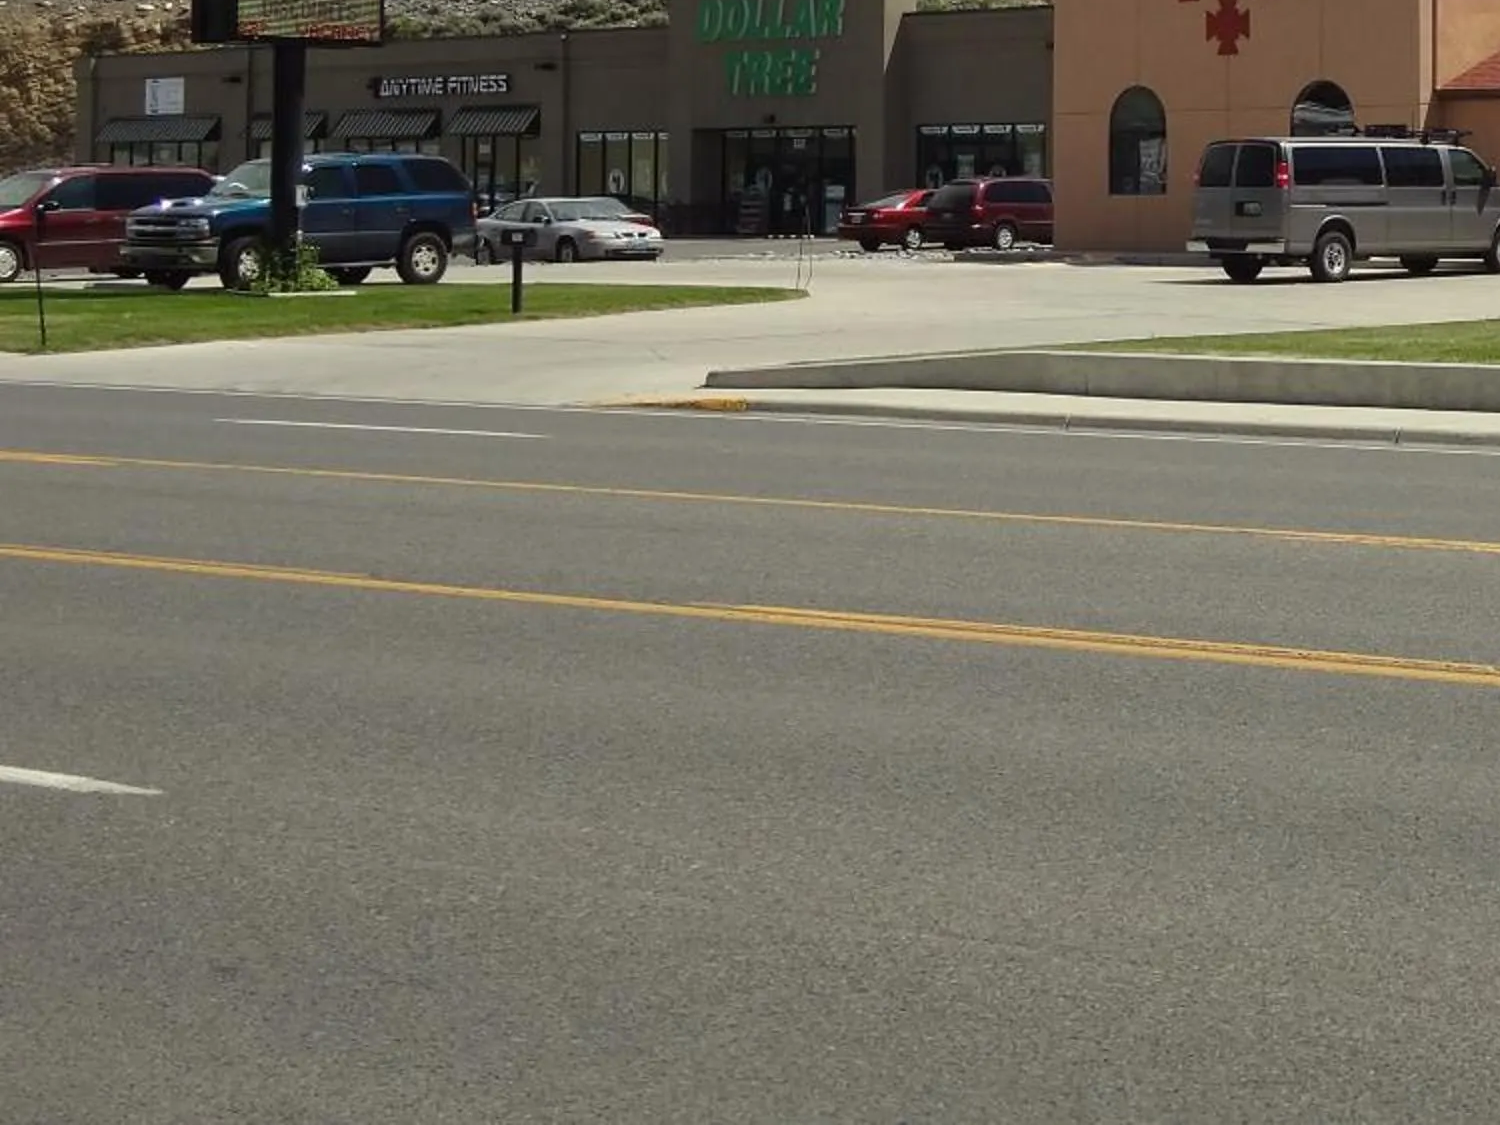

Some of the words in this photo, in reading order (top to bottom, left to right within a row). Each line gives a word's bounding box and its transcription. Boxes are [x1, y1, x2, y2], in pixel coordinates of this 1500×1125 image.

[379, 78, 444, 97] ANYTIME
[447, 75, 508, 94] FITNESS
[727, 48, 821, 96] TREE
